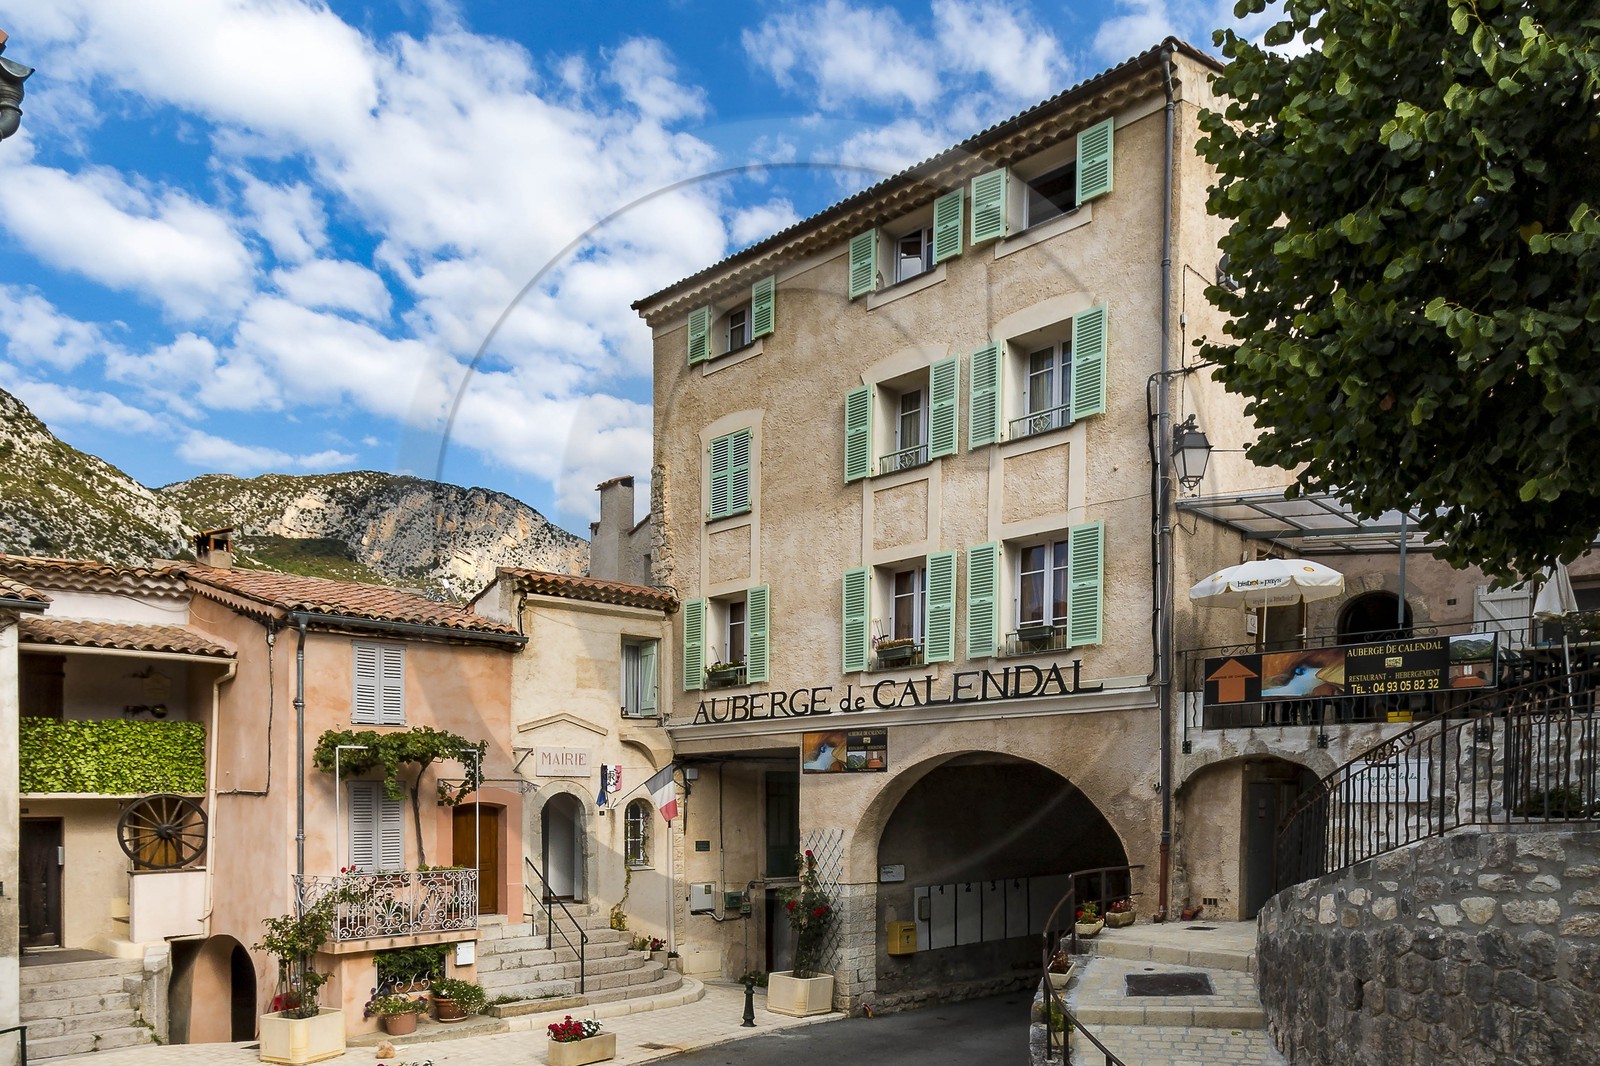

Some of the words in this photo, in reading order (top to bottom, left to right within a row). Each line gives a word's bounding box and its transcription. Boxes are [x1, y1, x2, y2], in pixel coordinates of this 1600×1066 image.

[1347, 645, 1384, 657] AUBERGE
[1386, 644, 1398, 654] DE
[1398, 641, 1443, 653] CALENDAL
[1348, 673, 1387, 682] RESTAURANT
[1395, 669, 1440, 679] HEBERGEMENT
[693, 686, 833, 725] AUBERGE
[839, 685, 866, 713] de
[872, 659, 1104, 709] CALENDAL
[1373, 682, 1384, 693] 04
[1387, 681, 1398, 692] 93
[1400, 680, 1411, 691] 05
[1413, 679, 1425, 690] 82
[1428, 678, 1439, 689] 32
[541, 752, 587, 766] MAIRIE
[938, 885, 944, 895] 1
[965, 882, 972, 892] 2
[990, 881, 996, 891] 3
[1014, 878, 1020, 889] 4
